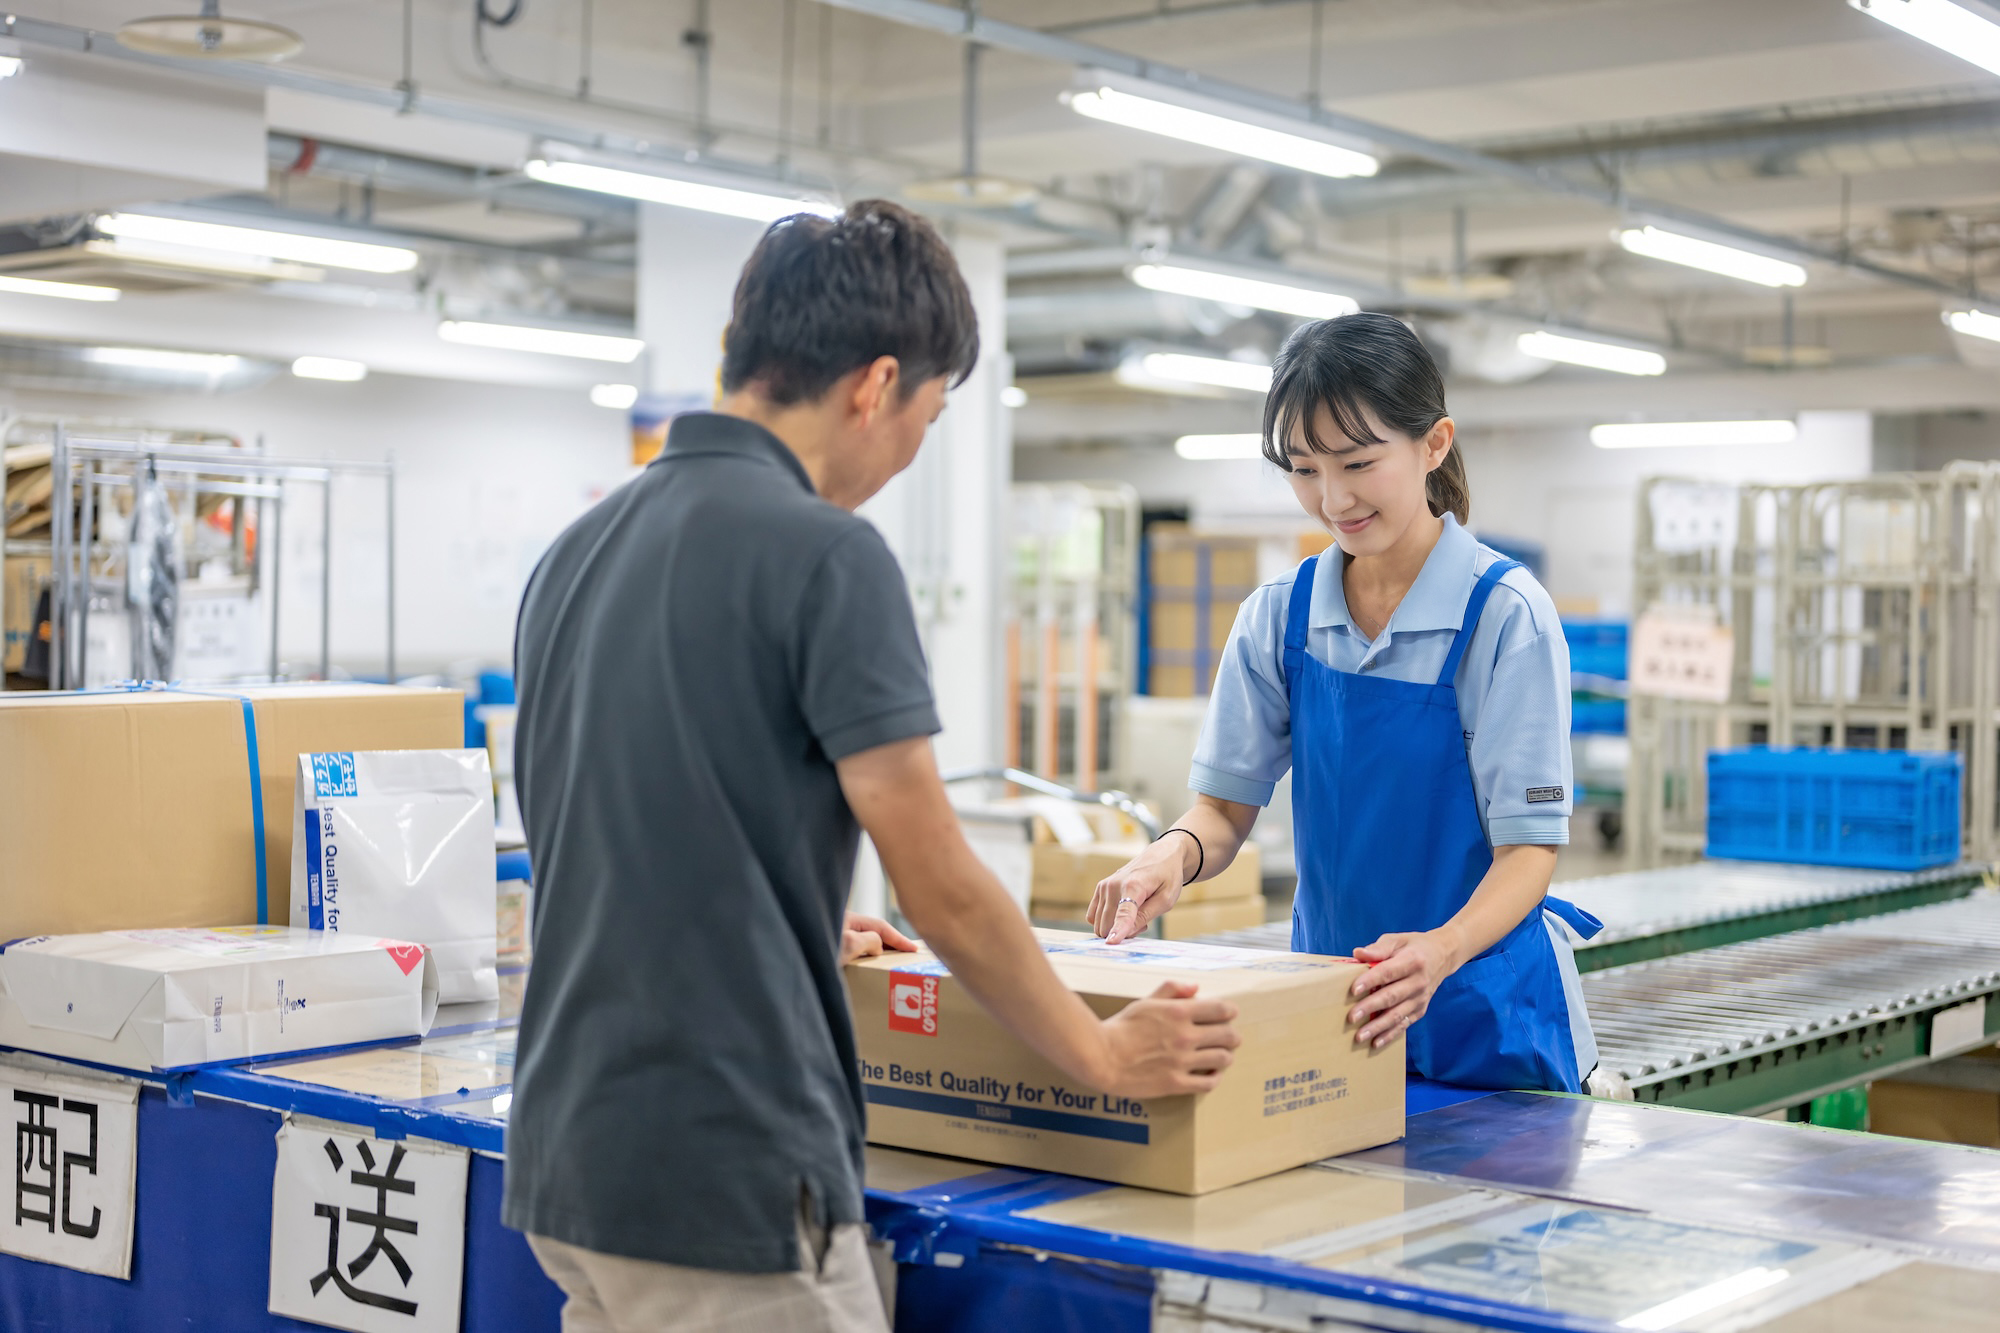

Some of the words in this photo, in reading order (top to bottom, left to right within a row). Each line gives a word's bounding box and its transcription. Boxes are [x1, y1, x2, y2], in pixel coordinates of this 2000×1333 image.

[314, 754, 330, 795] ガラス
[329, 754, 344, 795] ビン
[342, 754, 357, 795] セトモノ
[324, 845, 339, 904] Quality
[328, 908, 341, 932] for
[922, 977, 938, 1033] われもの
[857, 1059, 884, 1080] he
[889, 1063, 932, 1088] Best
[940, 1071, 1010, 1102] Quality
[1016, 1082, 1045, 1103] for
[1050, 1086, 1097, 1110] Your
[1102, 1094, 1149, 1119] Life.
[13, 1089, 101, 1239] 配
[310, 1138, 418, 1317] 送
